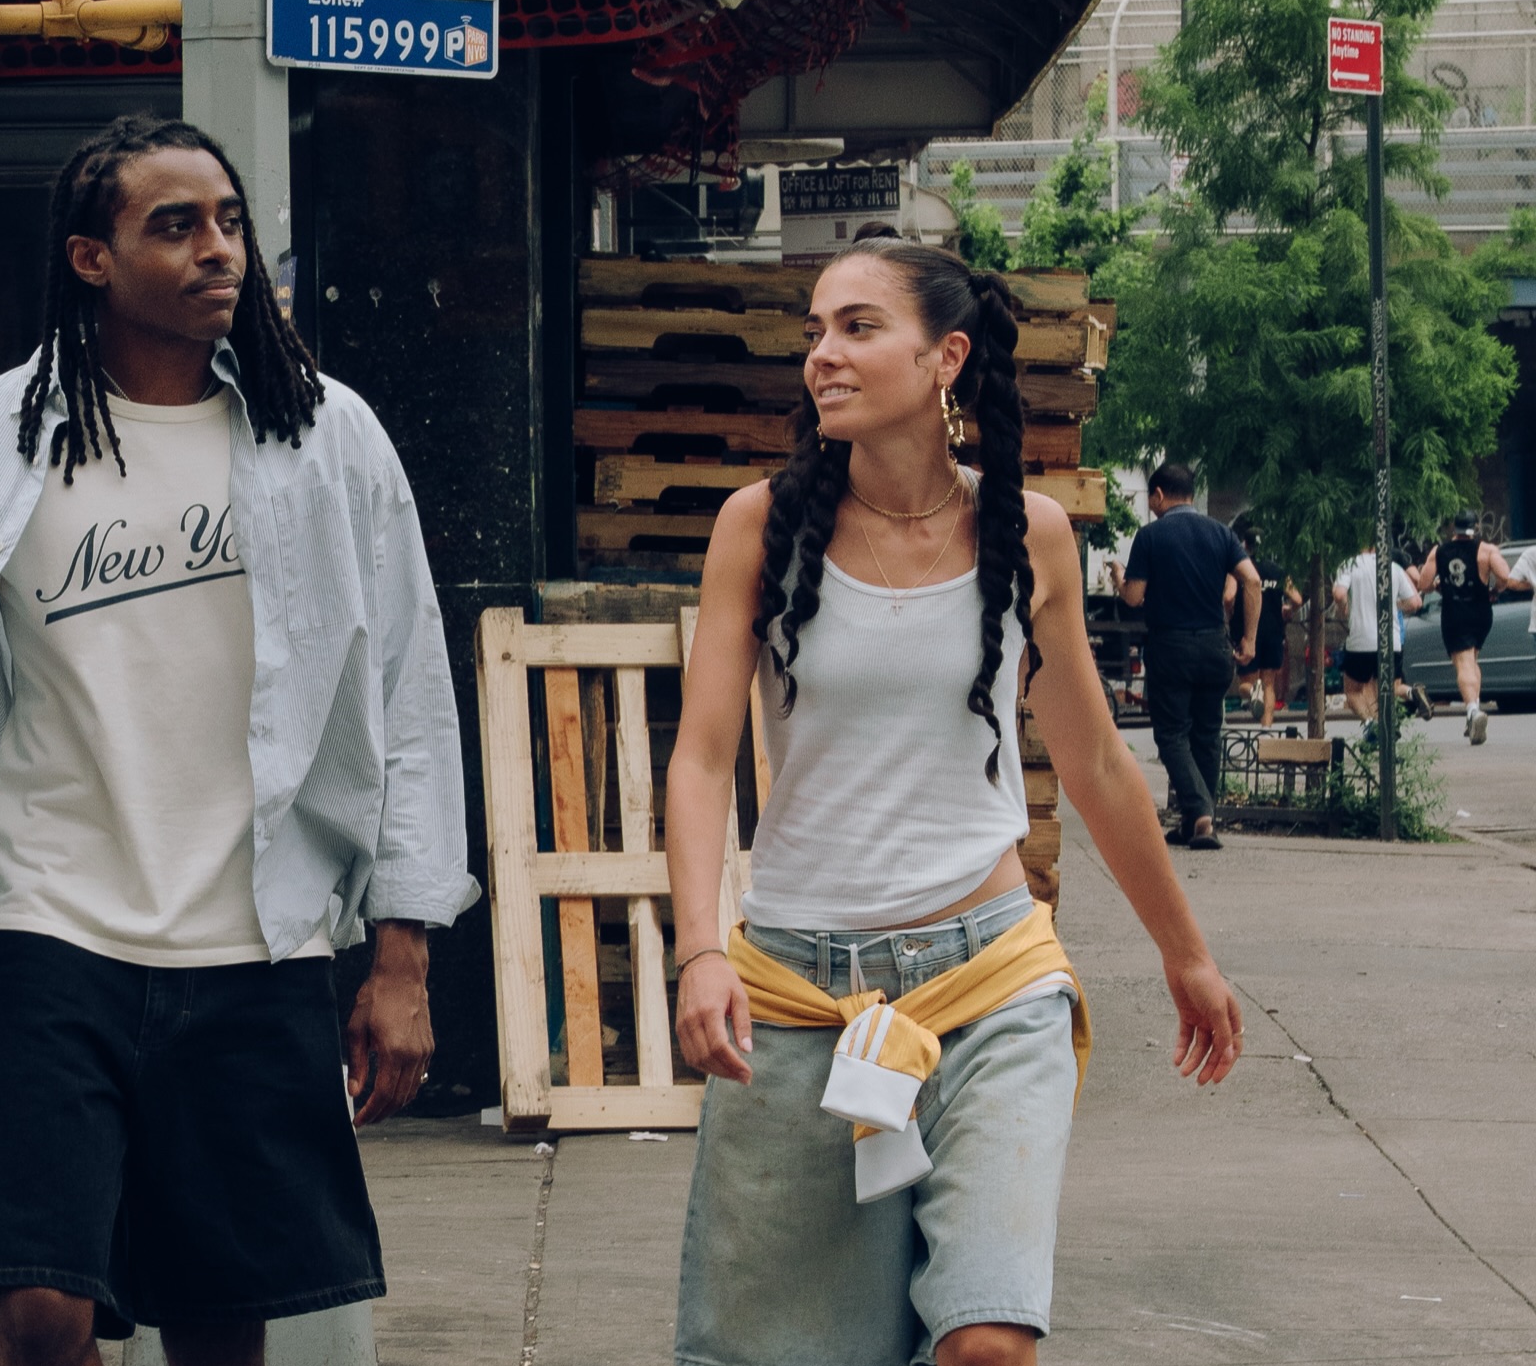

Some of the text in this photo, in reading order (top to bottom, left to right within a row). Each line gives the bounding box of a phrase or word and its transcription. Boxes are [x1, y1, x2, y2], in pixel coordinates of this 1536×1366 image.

[310, 15, 439, 63] 115999
[467, 28, 485, 45] PARK
[1331, 26, 1375, 45] NO STANDING
[467, 44, 486, 63] NYC
[1332, 43, 1360, 60] Anytime
[781, 175, 817, 193] OFFICE
[826, 173, 851, 191] LOFT
[853, 176, 870, 189] FOR
[871, 171, 898, 188] RENT
[35, 519, 164, 603] New
